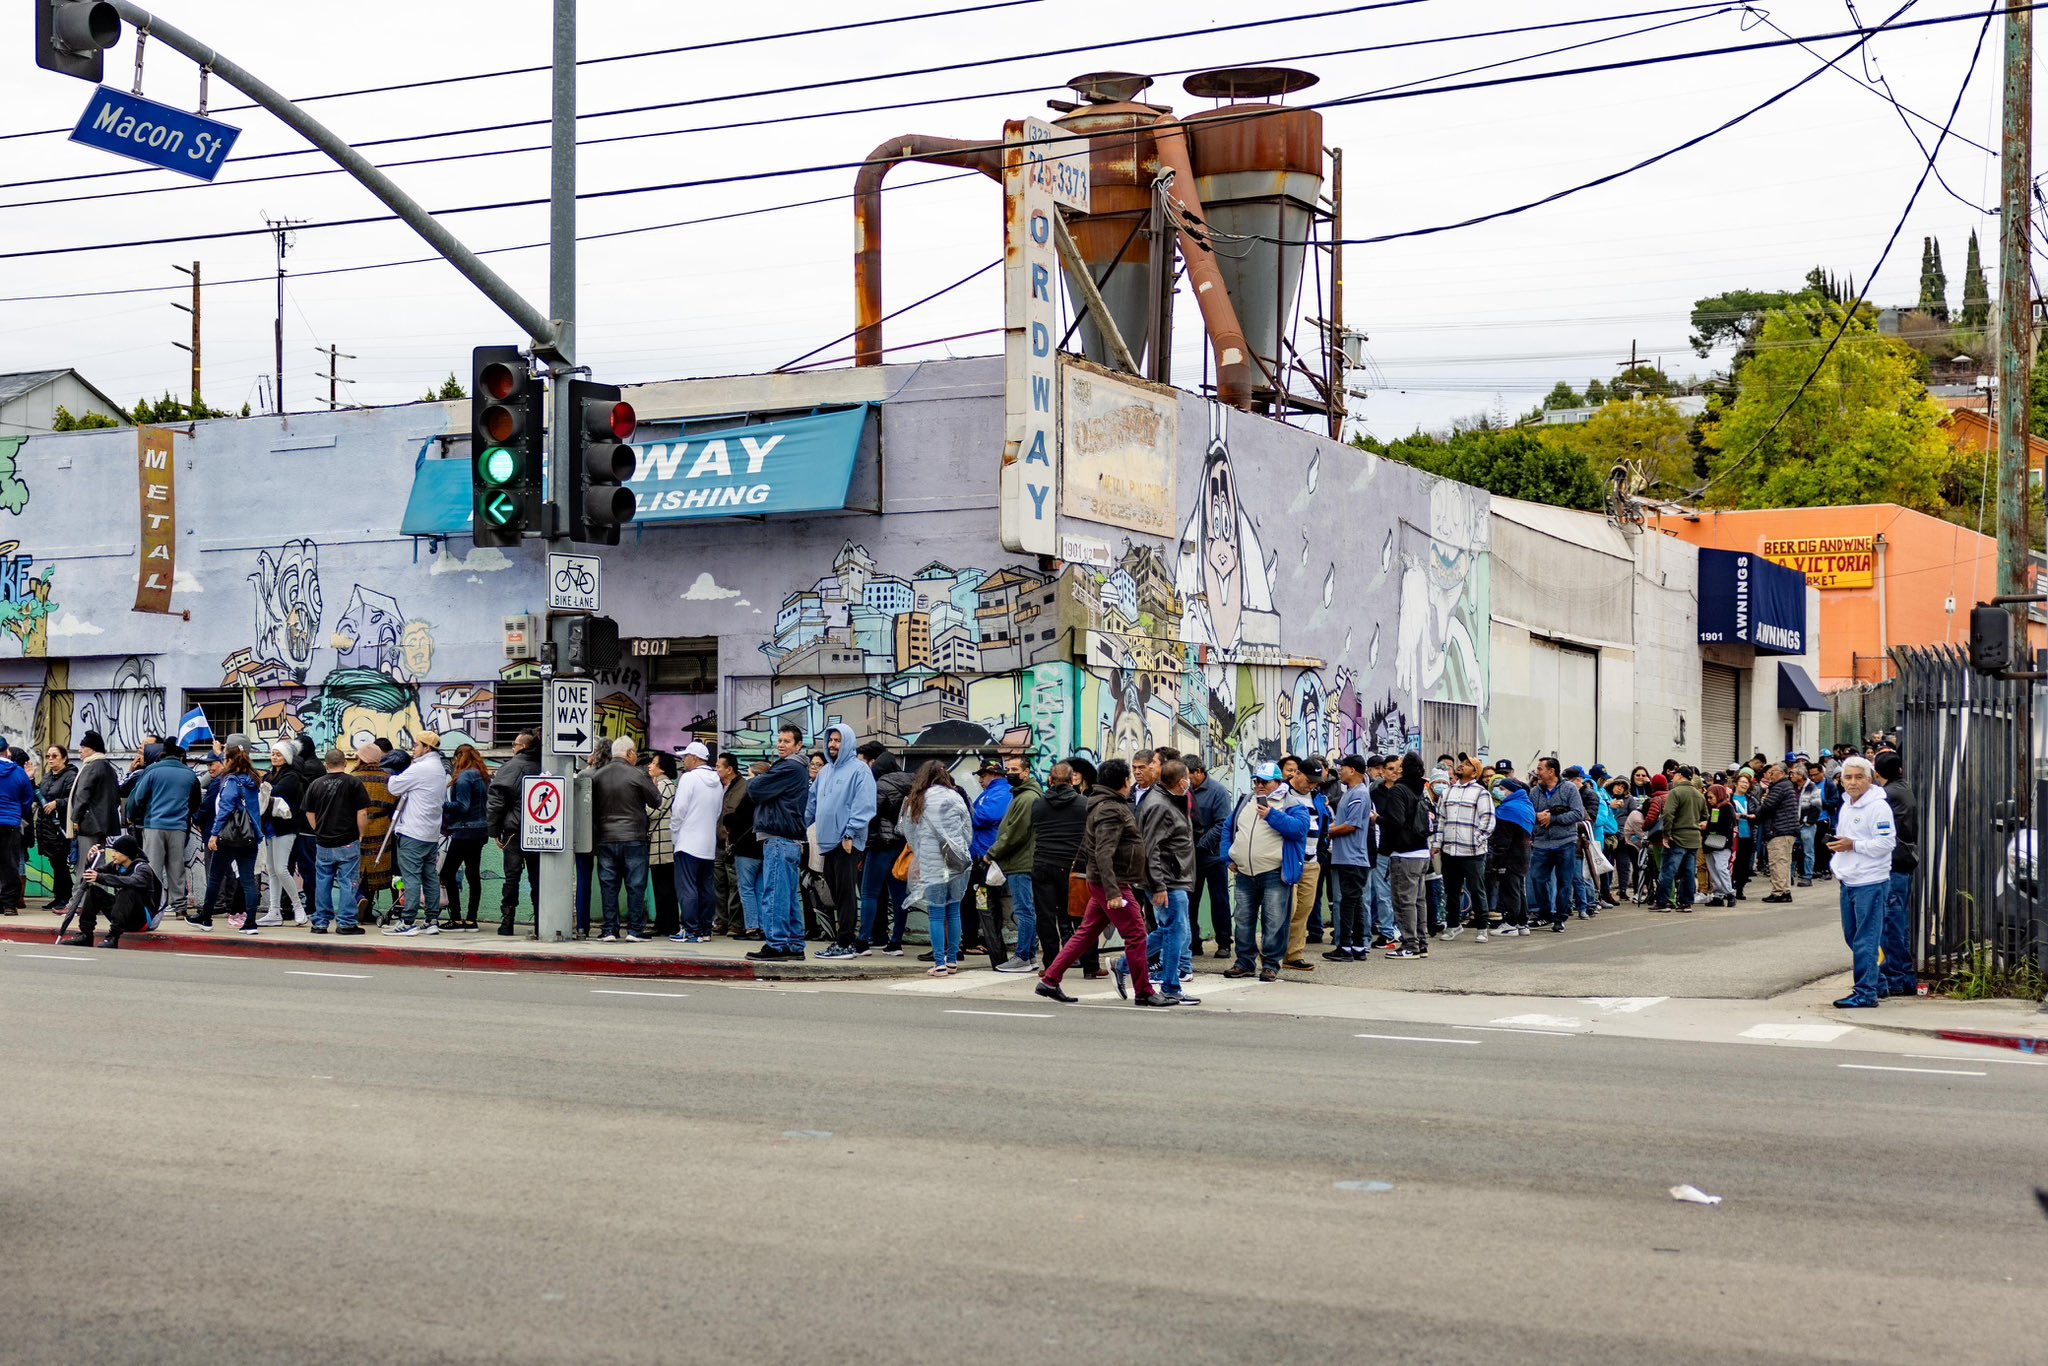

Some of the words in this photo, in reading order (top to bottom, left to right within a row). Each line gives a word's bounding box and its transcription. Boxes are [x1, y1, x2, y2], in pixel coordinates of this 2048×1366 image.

[92, 102, 184, 153] Macon
[187, 132, 222, 164] St
[1025, 208, 1050, 521] ORDWAY
[631, 434, 786, 482] WAY
[634, 483, 771, 512] LISHING
[144, 448, 170, 590] METAL
[1064, 540, 1082, 558] 1901
[1764, 540, 1796, 555] BEER
[1797, 539, 1817, 553] CIG
[1793, 554, 1872, 574] VICTORIA
[0, 553, 35, 605] KE
[1806, 575, 1837, 586] RKET
[554, 594, 572, 606] BIKE
[574, 596, 594, 608] LANE
[1736, 556, 1749, 641] AWNINGS
[1700, 632, 1723, 642] 1901
[1756, 622, 1800, 651] AWNINGS
[632, 639, 668, 657] 1901
[557, 686, 588, 704] ONE
[557, 707, 588, 725] WAY
[529, 824, 543, 835] USE
[526, 836, 560, 848] CROSSWALK
